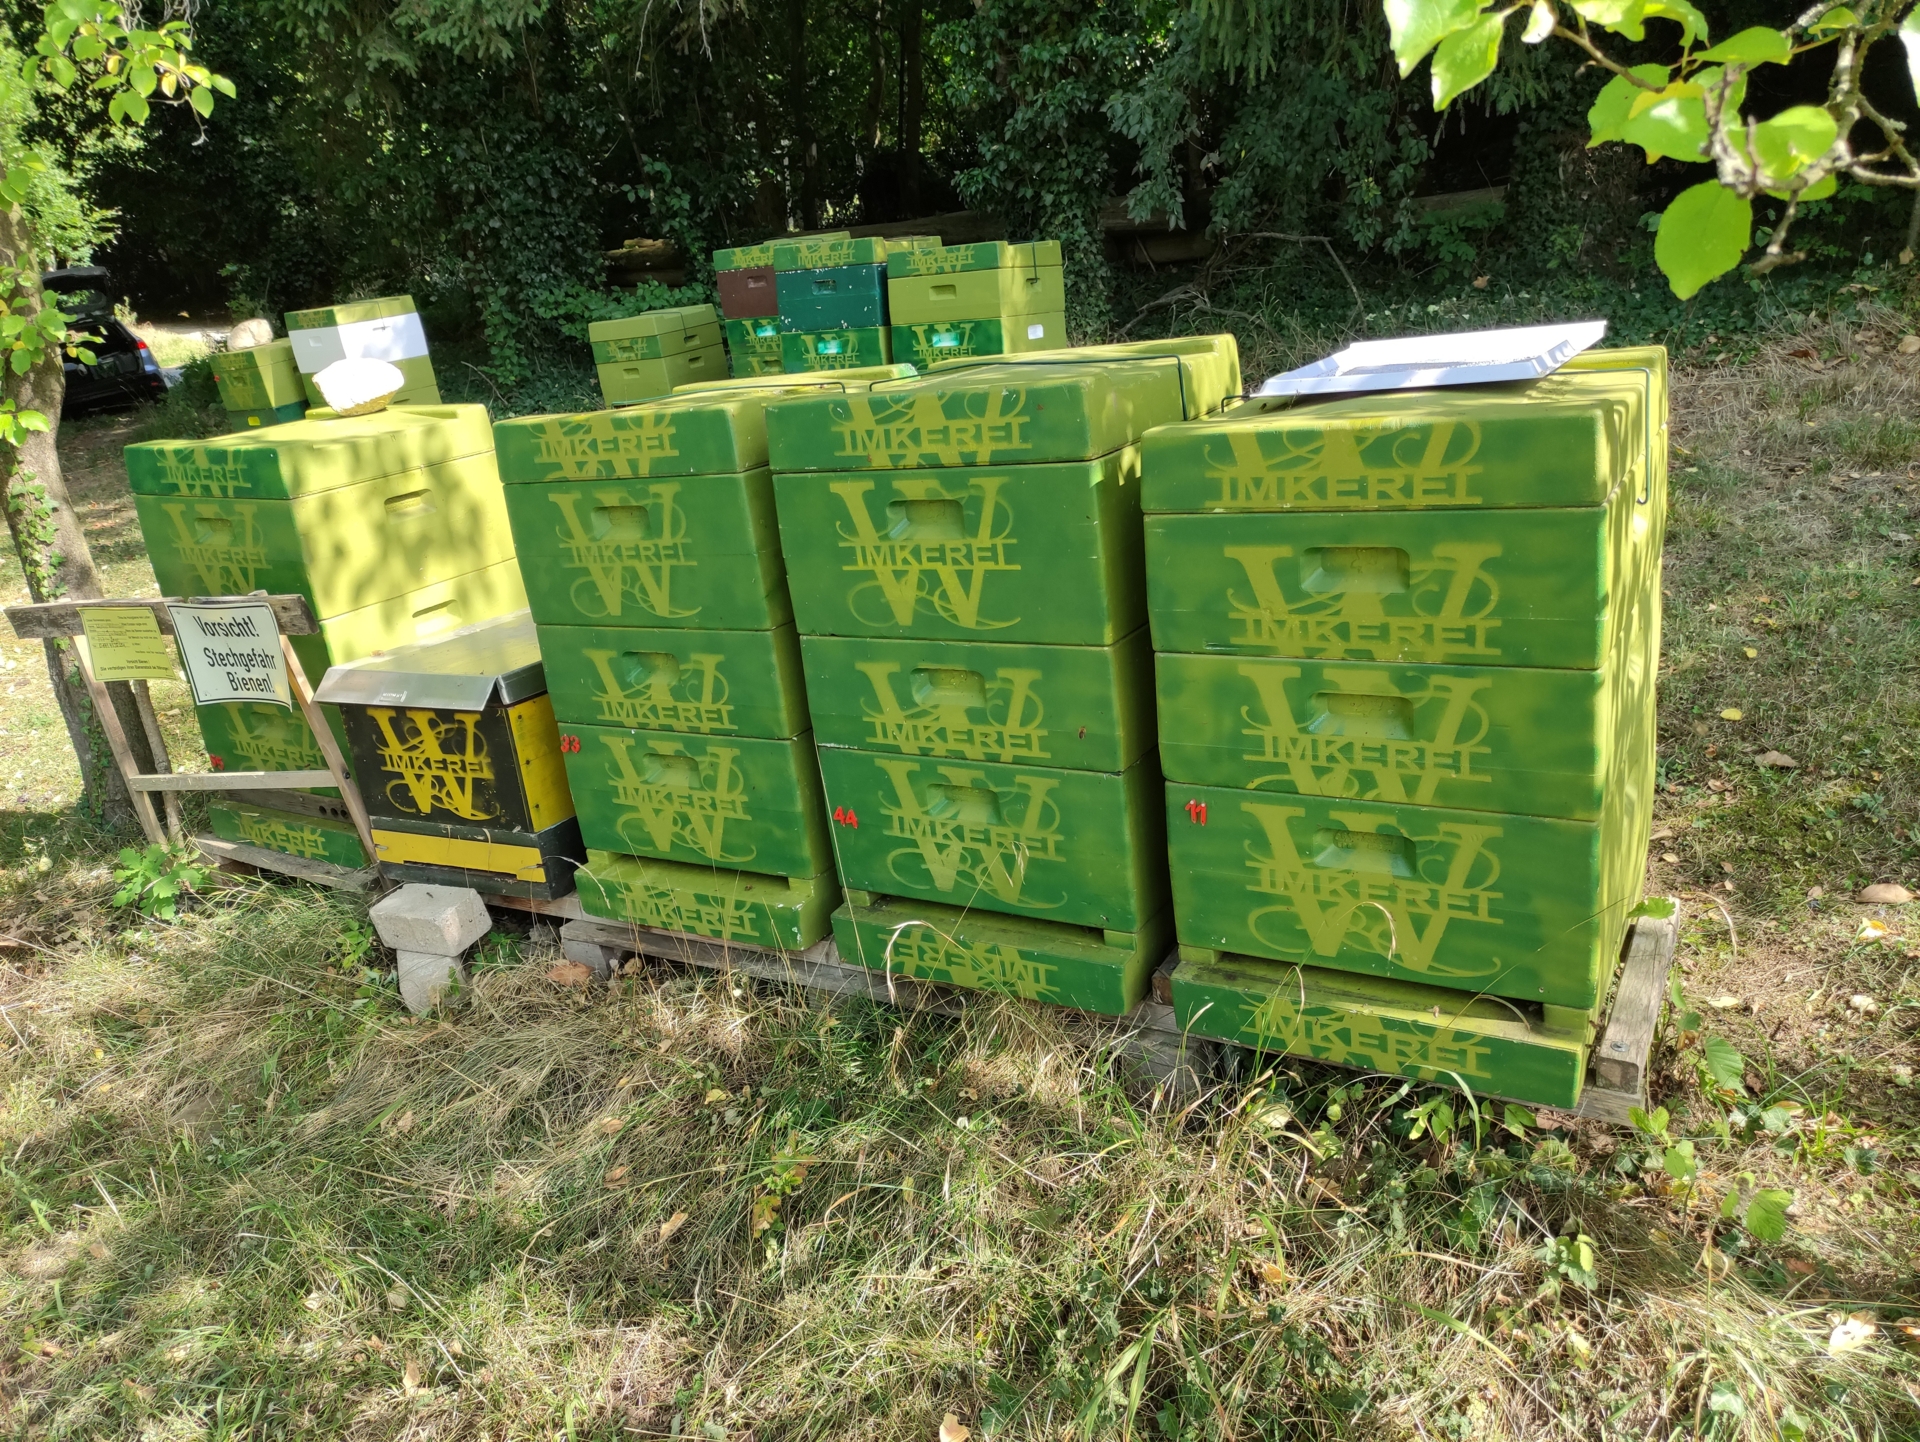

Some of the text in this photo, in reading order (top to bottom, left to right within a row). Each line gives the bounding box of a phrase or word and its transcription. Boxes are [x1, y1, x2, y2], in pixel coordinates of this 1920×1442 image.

[731, 254, 774, 267] IMKERE
[798, 249, 856, 266] IMKEREI
[906, 251, 975, 269] IMKEREI
[804, 353, 860, 367] IMKEREI
[913, 346, 977, 360] IMKEREI
[530, 427, 679, 463] IMKEREI
[830, 416, 1032, 456] IMKEREI
[157, 463, 251, 488] IMKEREI
[1204, 466, 1483, 507] IMKEREI
[172, 543, 272, 570] IMKEREI
[559, 538, 697, 568] IMKEREI
[838, 539, 1021, 570] IMKEREI
[193, 615, 260, 637] Vorsicht!
[1228, 612, 1501, 656] IMKEREI
[203, 647, 276, 673] Stechgefahr
[226, 671, 275, 693] Bienen!
[592, 696, 738, 730] IMKEREI
[560, 734, 581, 754] 33
[862, 716, 1051, 759] IMKEREI
[377, 750, 495, 780] IMKEREI
[1242, 729, 1492, 782] IMKEREI
[608, 779, 752, 821] IMKEREI
[833, 805, 859, 829] 44
[233, 819, 329, 856] IMKEREI
[878, 807, 1066, 863] IMKEREI
[1245, 860, 1503, 925] IMKEREI
[616, 893, 760, 937] IMKEREI
[1238, 1004, 1491, 1079] IMKEREI
